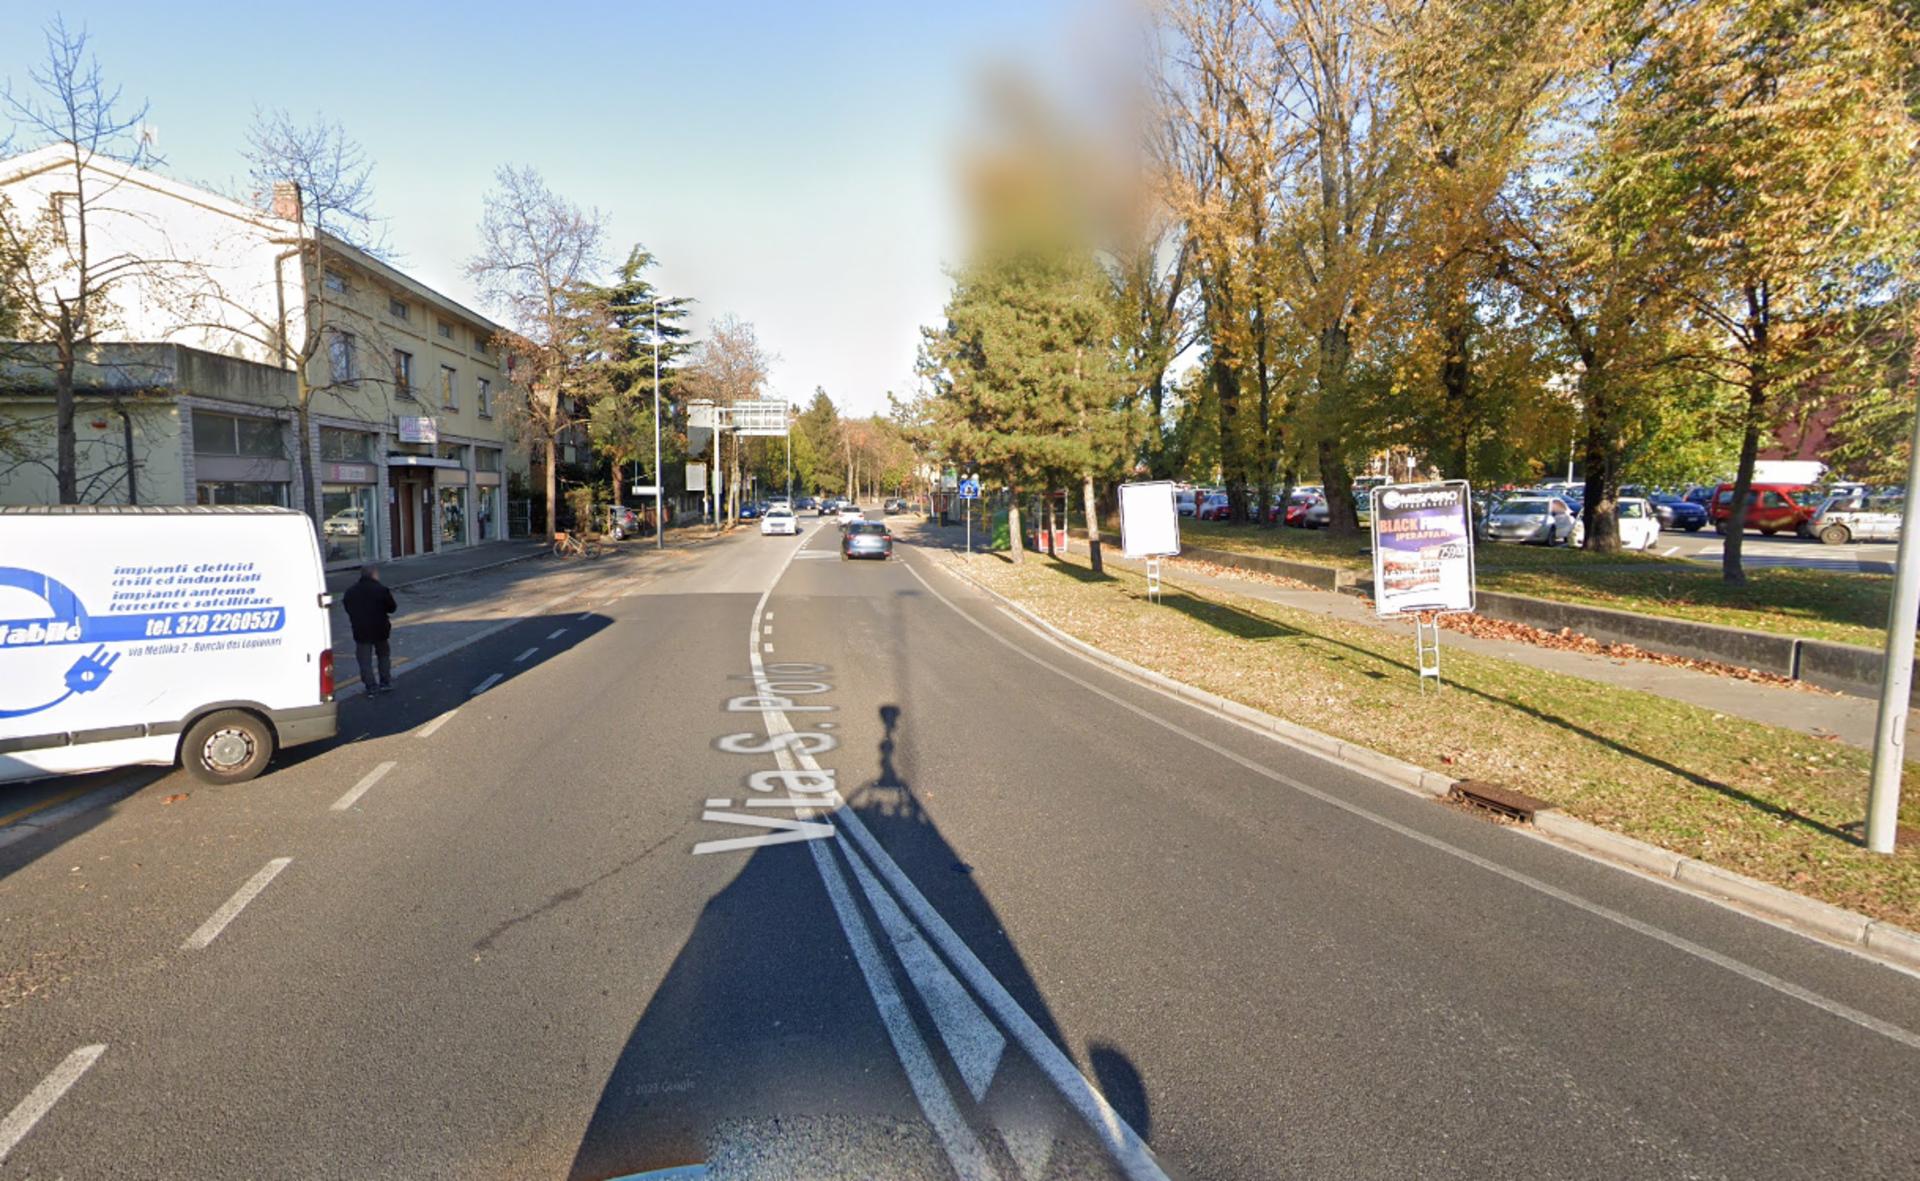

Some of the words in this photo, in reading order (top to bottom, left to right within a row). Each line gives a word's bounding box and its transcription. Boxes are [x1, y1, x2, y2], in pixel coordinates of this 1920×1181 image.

[1380, 518, 1418, 533] BLACK
[114, 564, 188, 575] impianti
[193, 562, 254, 573] elettrici
[112, 576, 152, 586] civili
[155, 575, 174, 585] ed
[177, 572, 261, 584] industriali
[112, 588, 187, 600] impianti
[189, 587, 256, 597] antenna
[109, 600, 179, 611] terrestre
[182, 600, 191, 608] e
[195, 597, 273, 608] satellitare
[145, 616, 173, 636] tel.
[176, 614, 209, 634] 328
[209, 610, 280, 633] 2260537
[181, 642, 188, 653] 2
